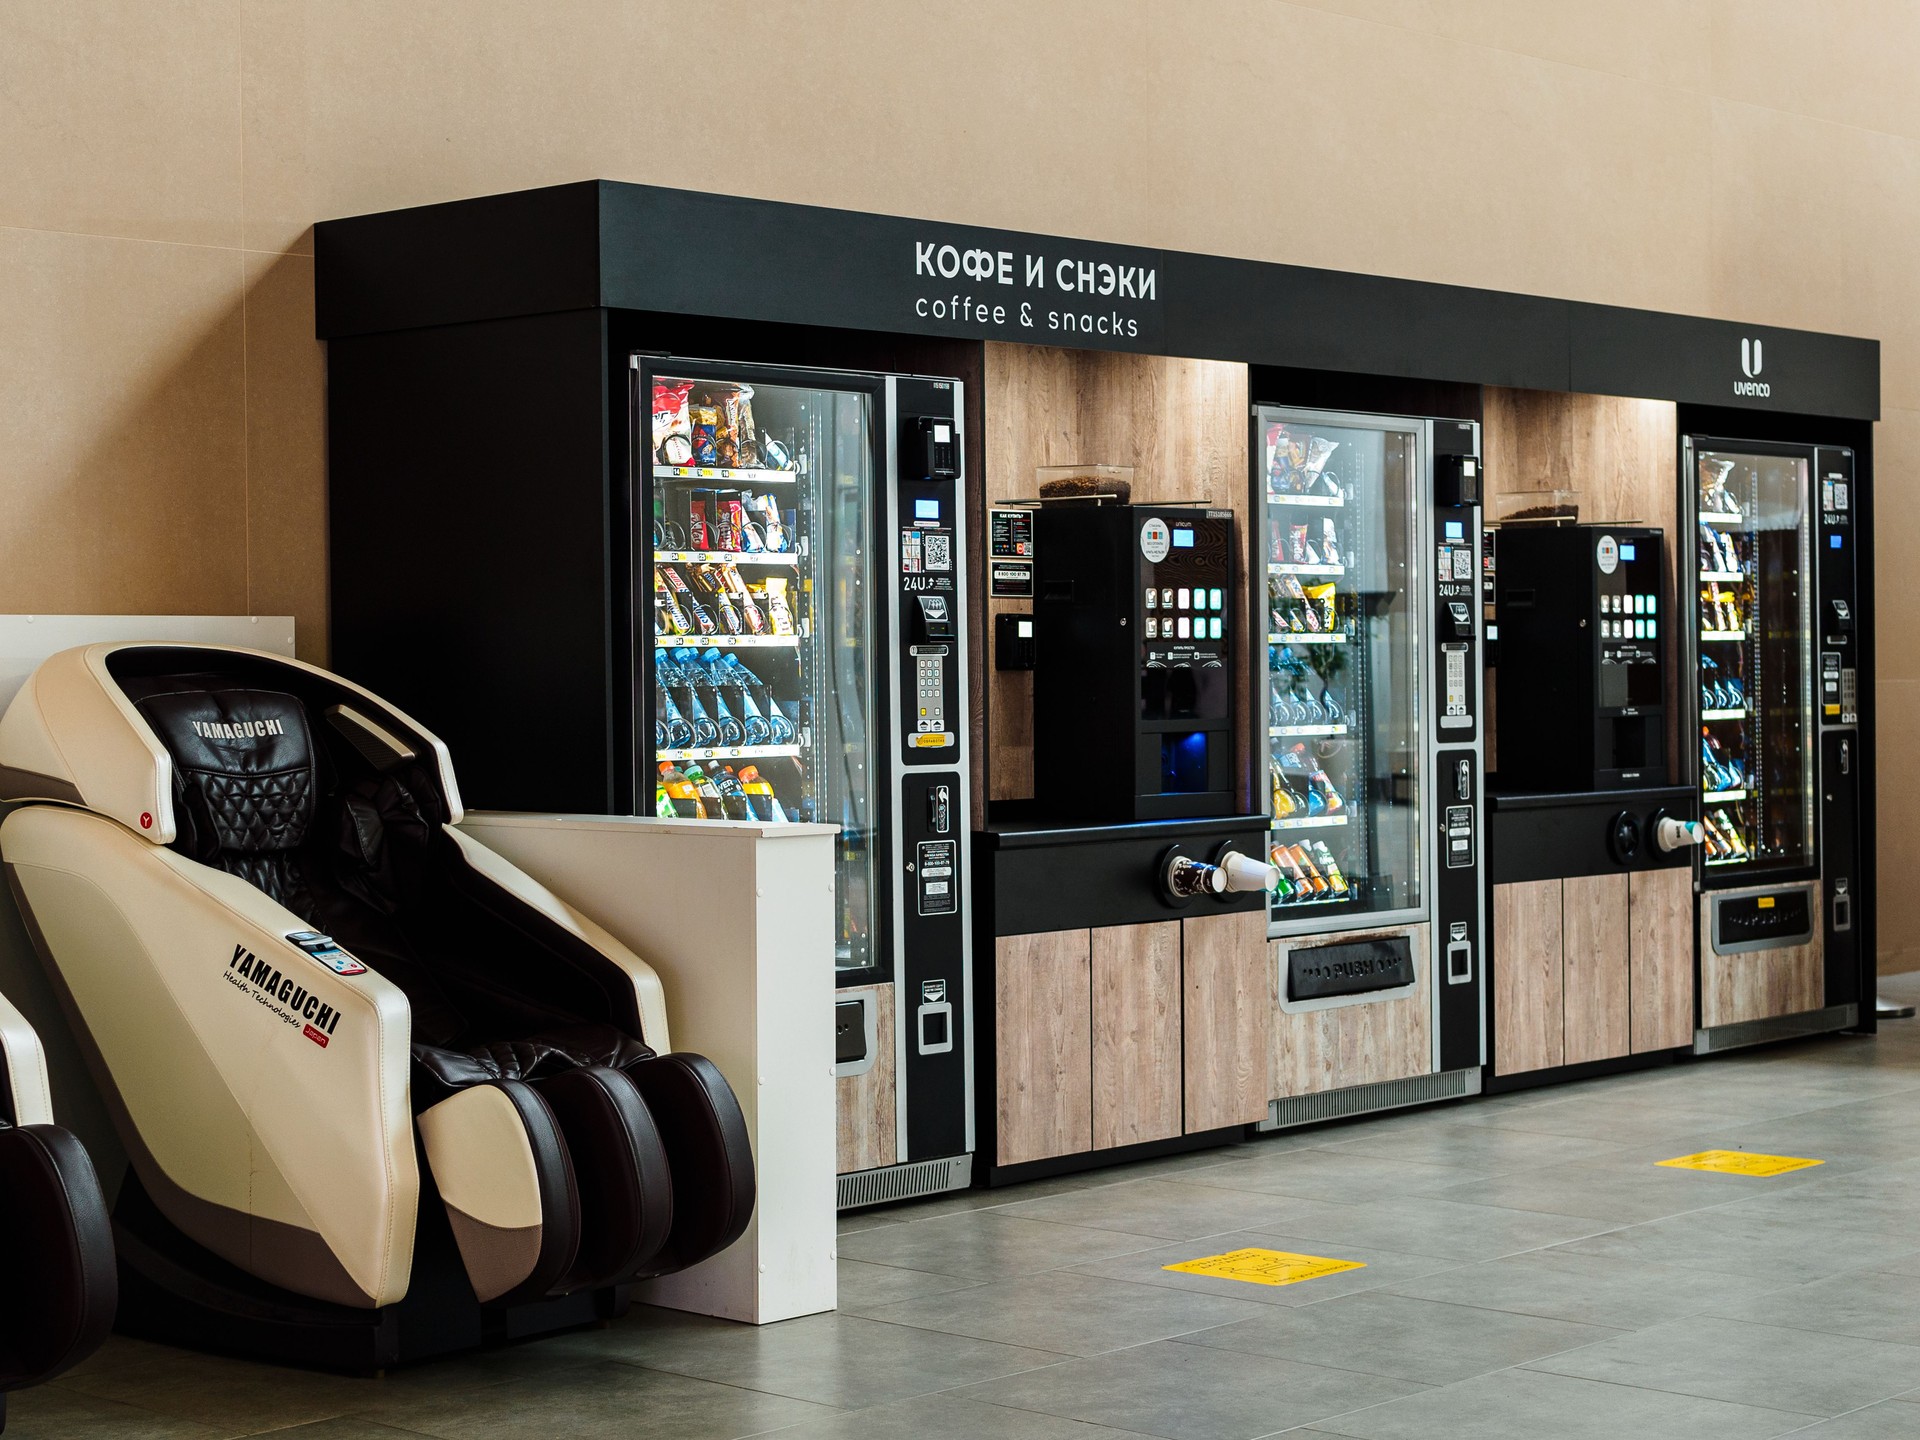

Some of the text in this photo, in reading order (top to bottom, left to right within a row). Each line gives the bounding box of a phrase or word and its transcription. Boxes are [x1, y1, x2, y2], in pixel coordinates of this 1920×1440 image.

[915, 241, 1156, 301] КОФЕ И СНЭКИ
[915, 295, 1138, 338] coffee & snacks
[1733, 381, 1770, 398] uvenco
[903, 577, 926, 591] 24U
[1439, 584, 1455, 596] 24U
[192, 719, 284, 739] YAMAGUCHI
[1332, 958, 1375, 979] PUSH
[229, 943, 342, 1035] YAMAGUCHI
[223, 970, 301, 1029] Health Technologies
[305, 1027, 326, 1044] Japan
